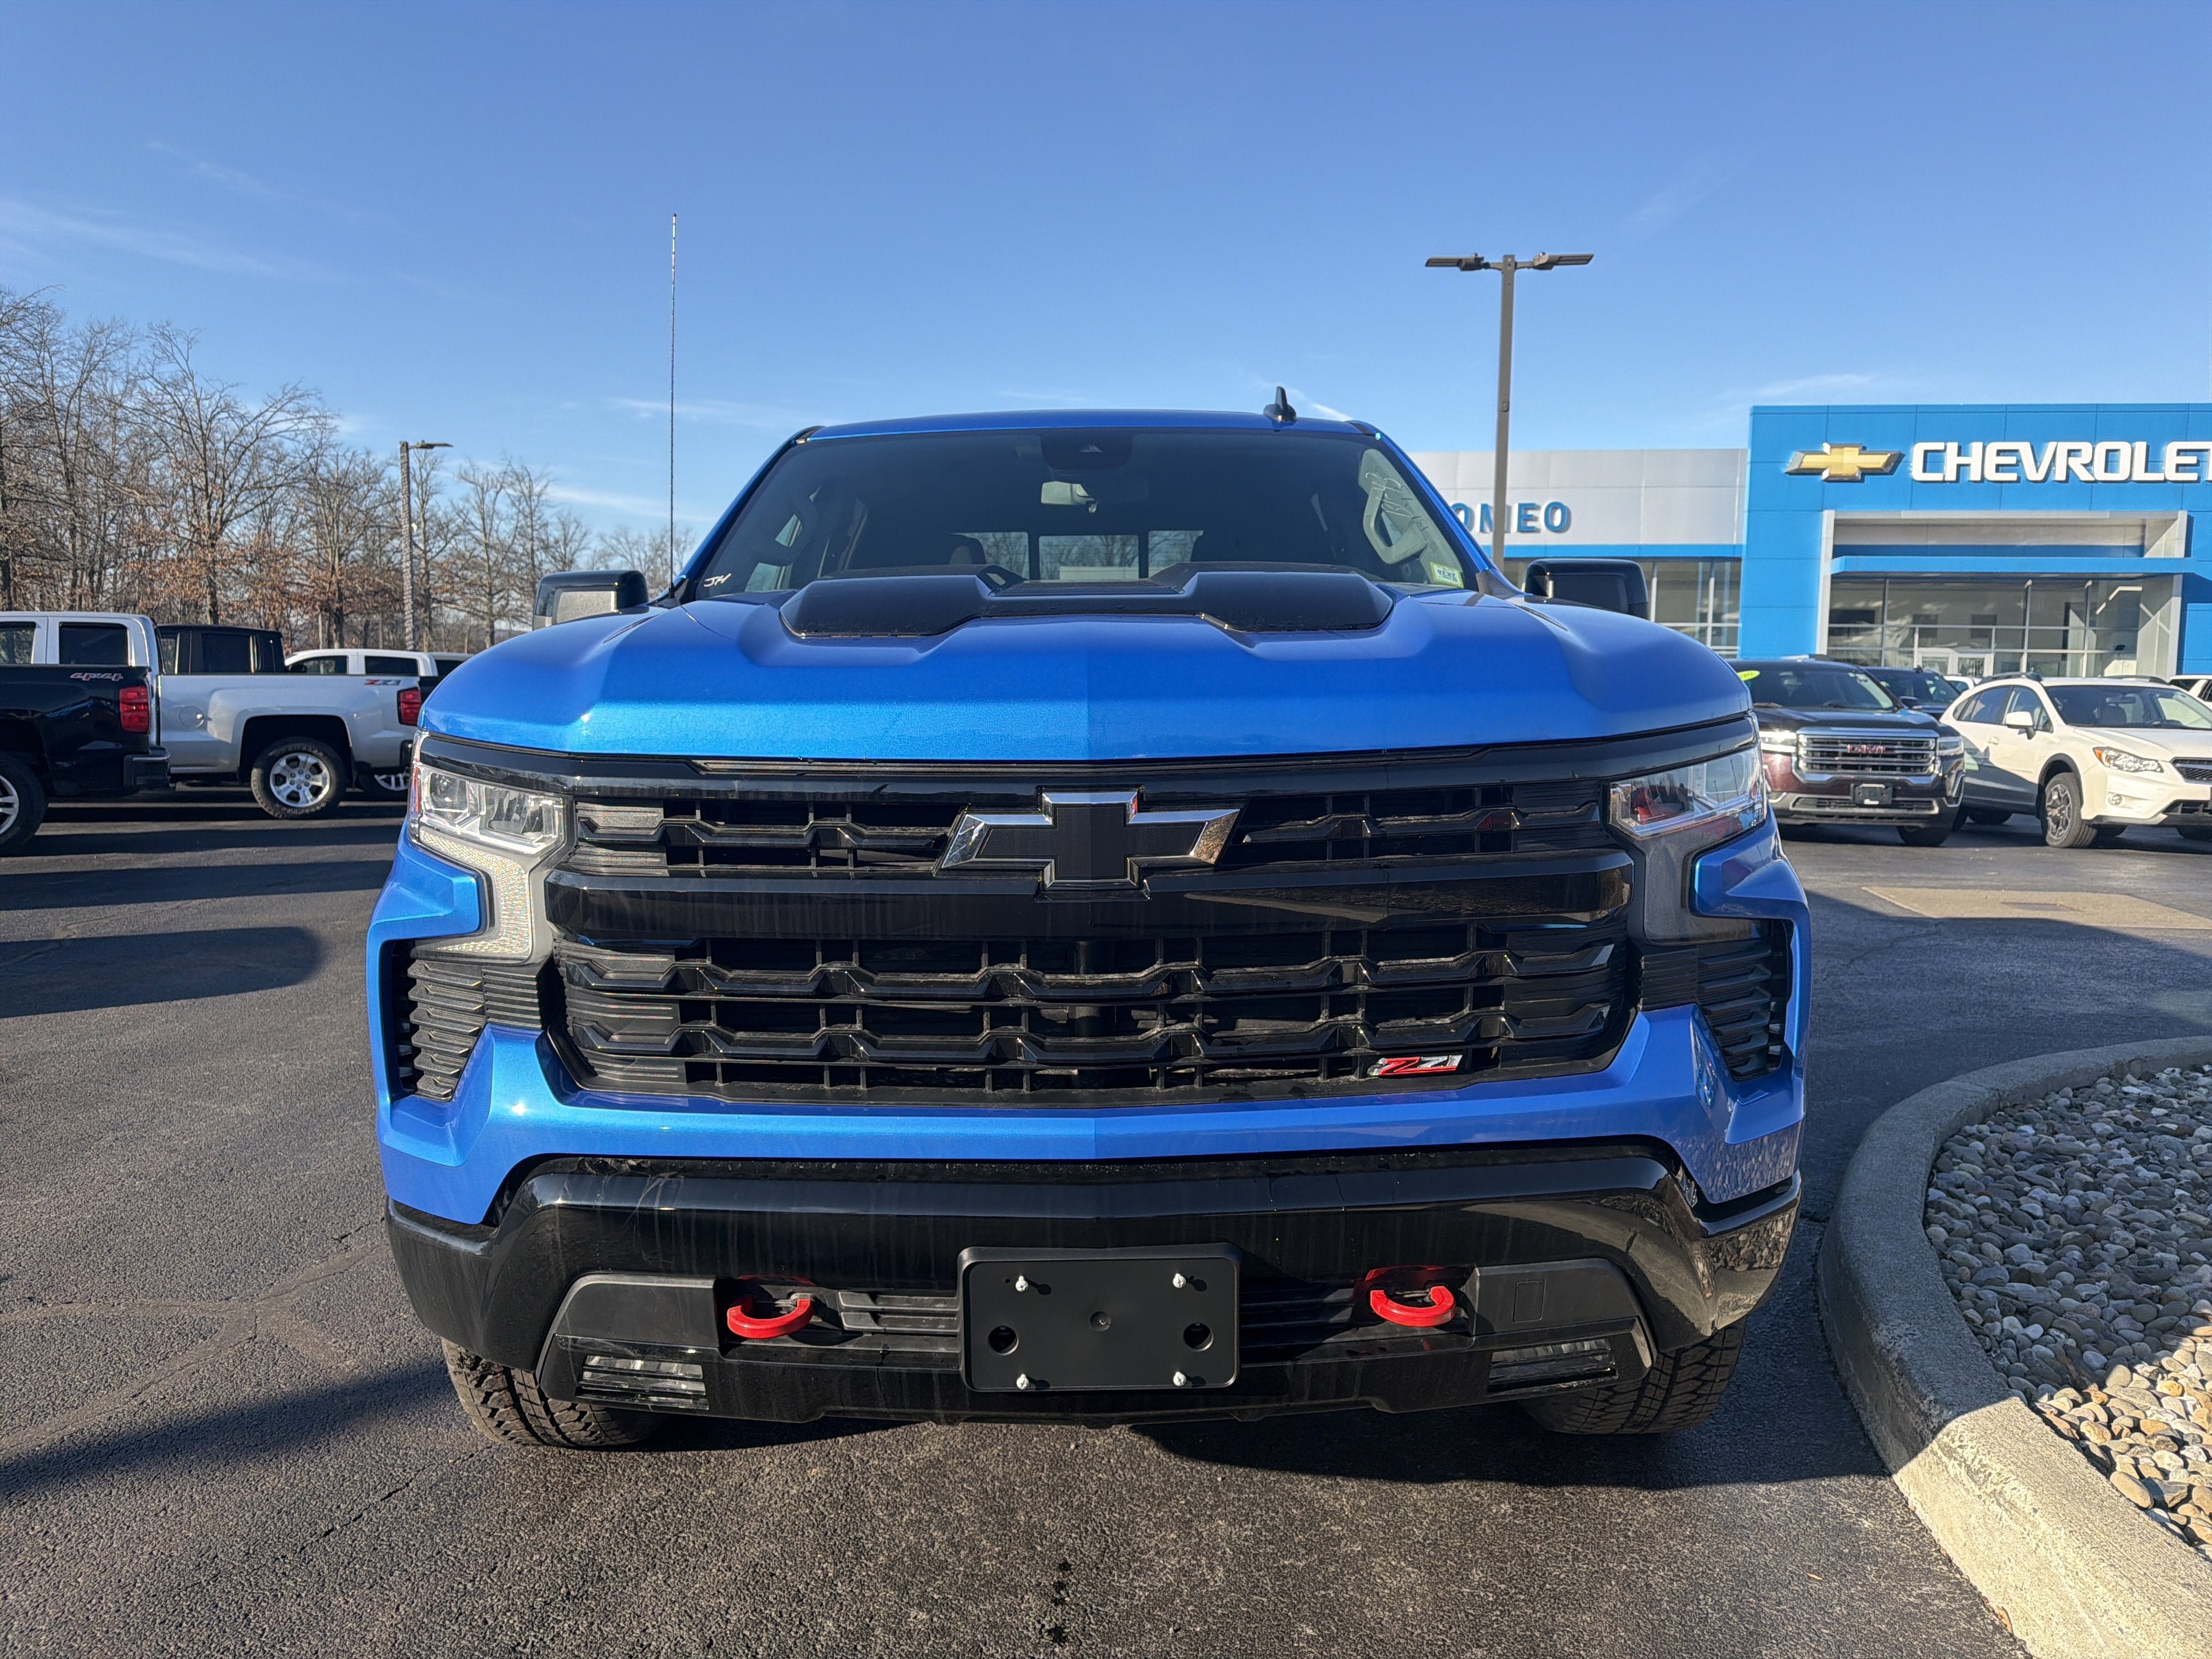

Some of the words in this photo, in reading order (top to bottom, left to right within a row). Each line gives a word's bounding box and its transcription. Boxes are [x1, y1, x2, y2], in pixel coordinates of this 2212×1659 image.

[1912, 441, 2212, 482] CHEVROLE
[703, 573, 732, 587] JH
[1369, 1054, 1463, 1076] Z71
